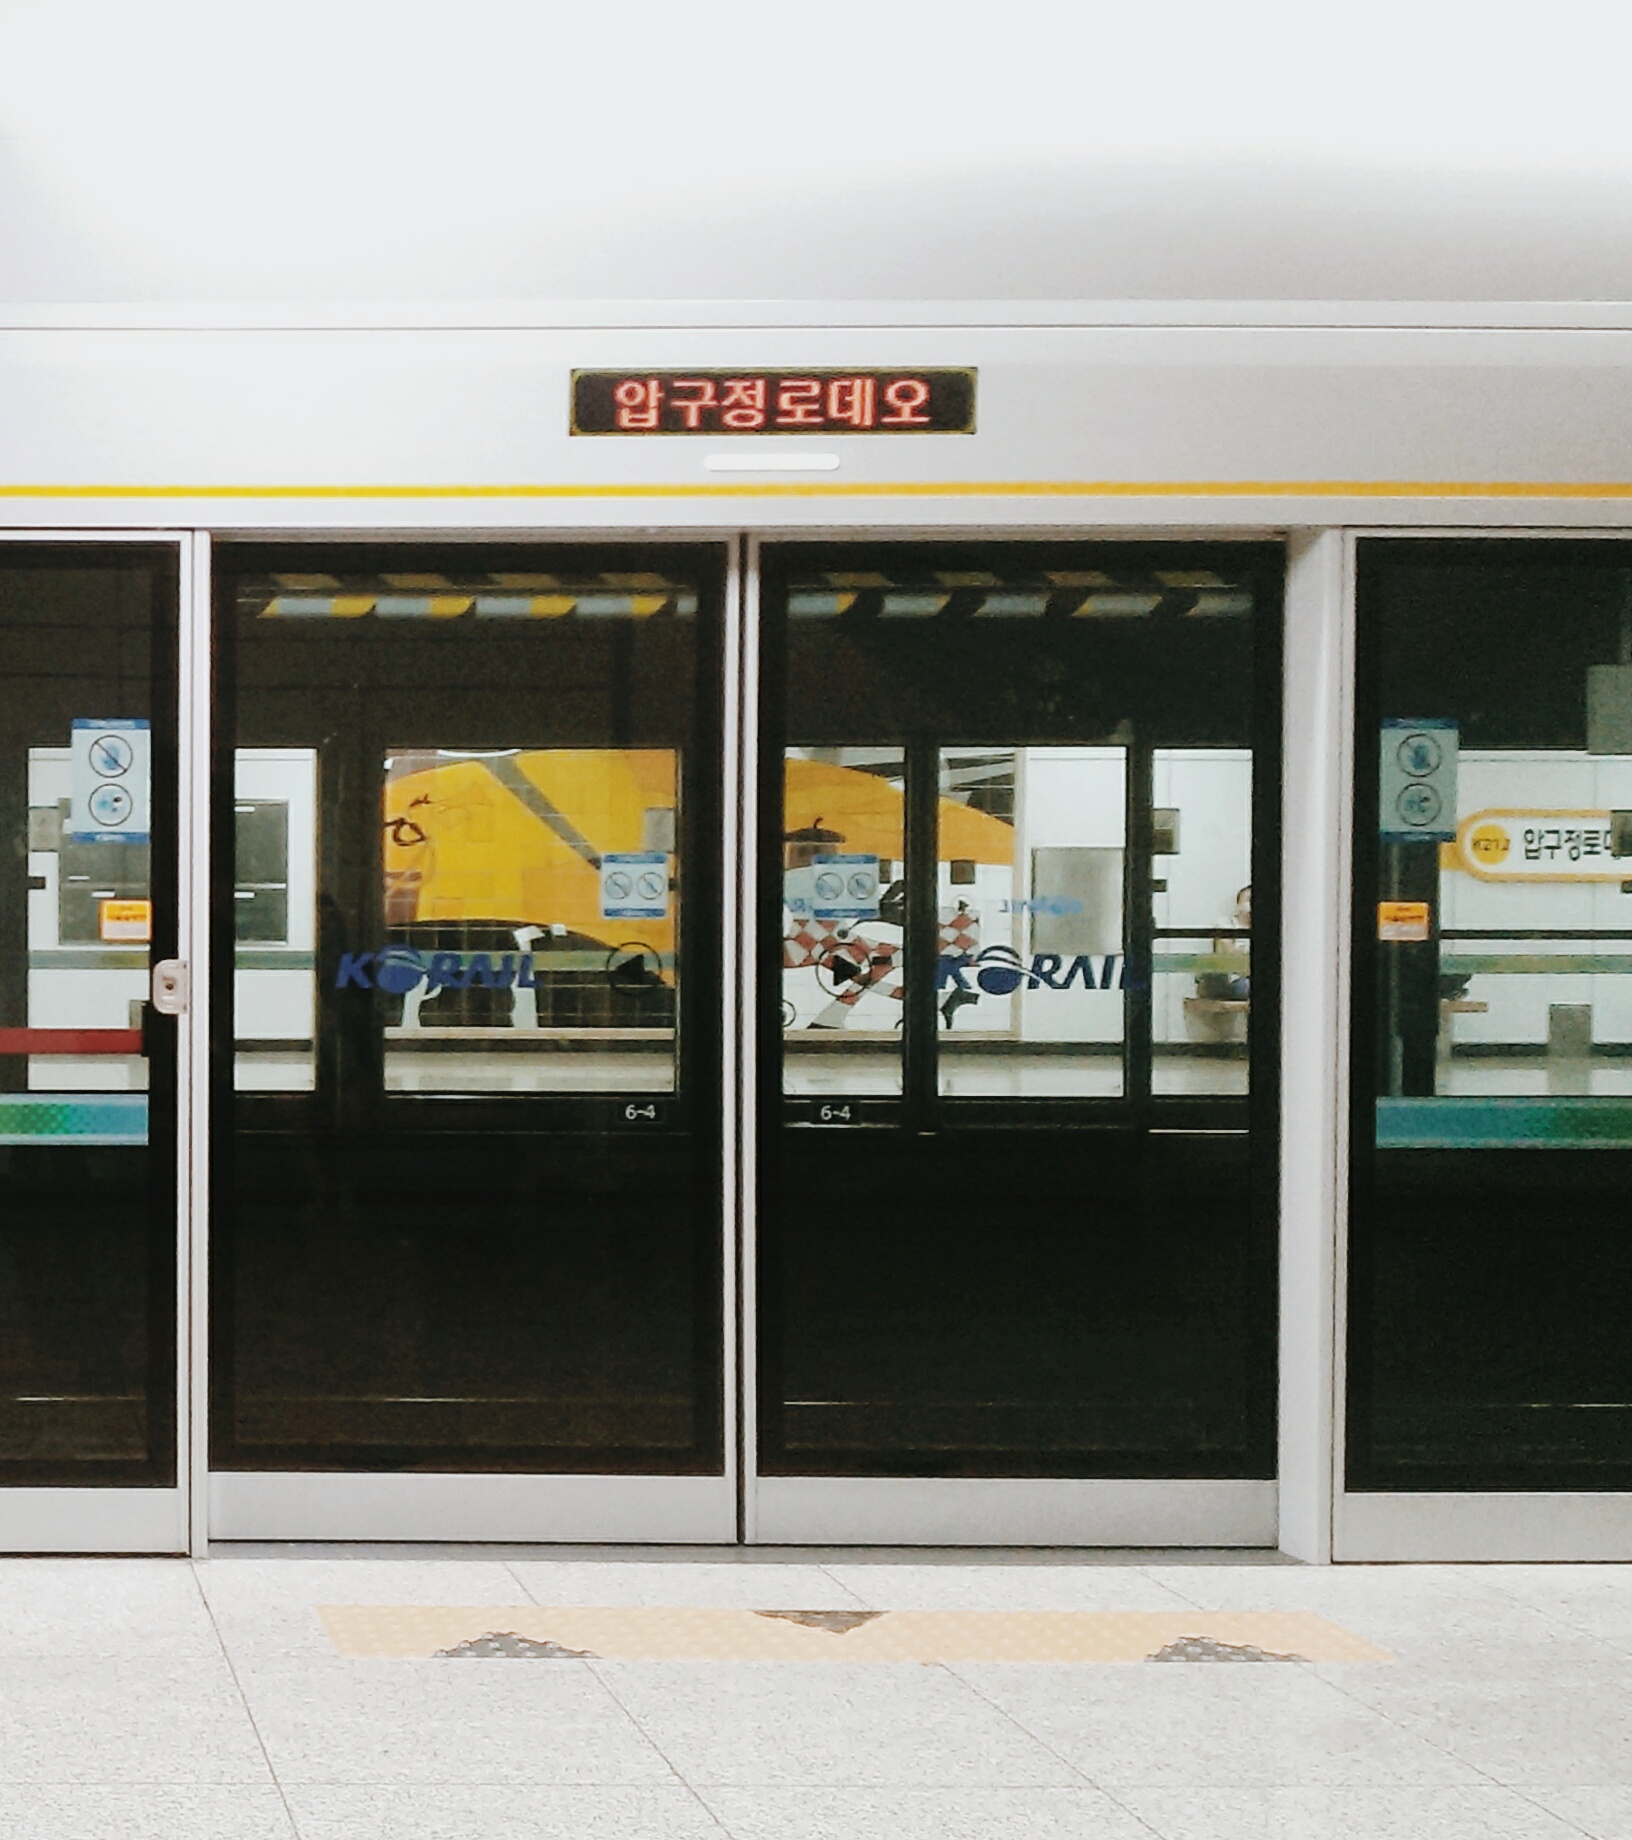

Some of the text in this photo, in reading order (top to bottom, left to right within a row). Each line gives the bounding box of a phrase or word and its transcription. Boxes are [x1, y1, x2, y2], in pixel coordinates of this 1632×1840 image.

[614, 378, 931, 428] 압구정로데오
[335, 944, 544, 994] KORAIL
[932, 945, 1150, 995] KORAIL
[820, 1105, 851, 1121] 6-4
